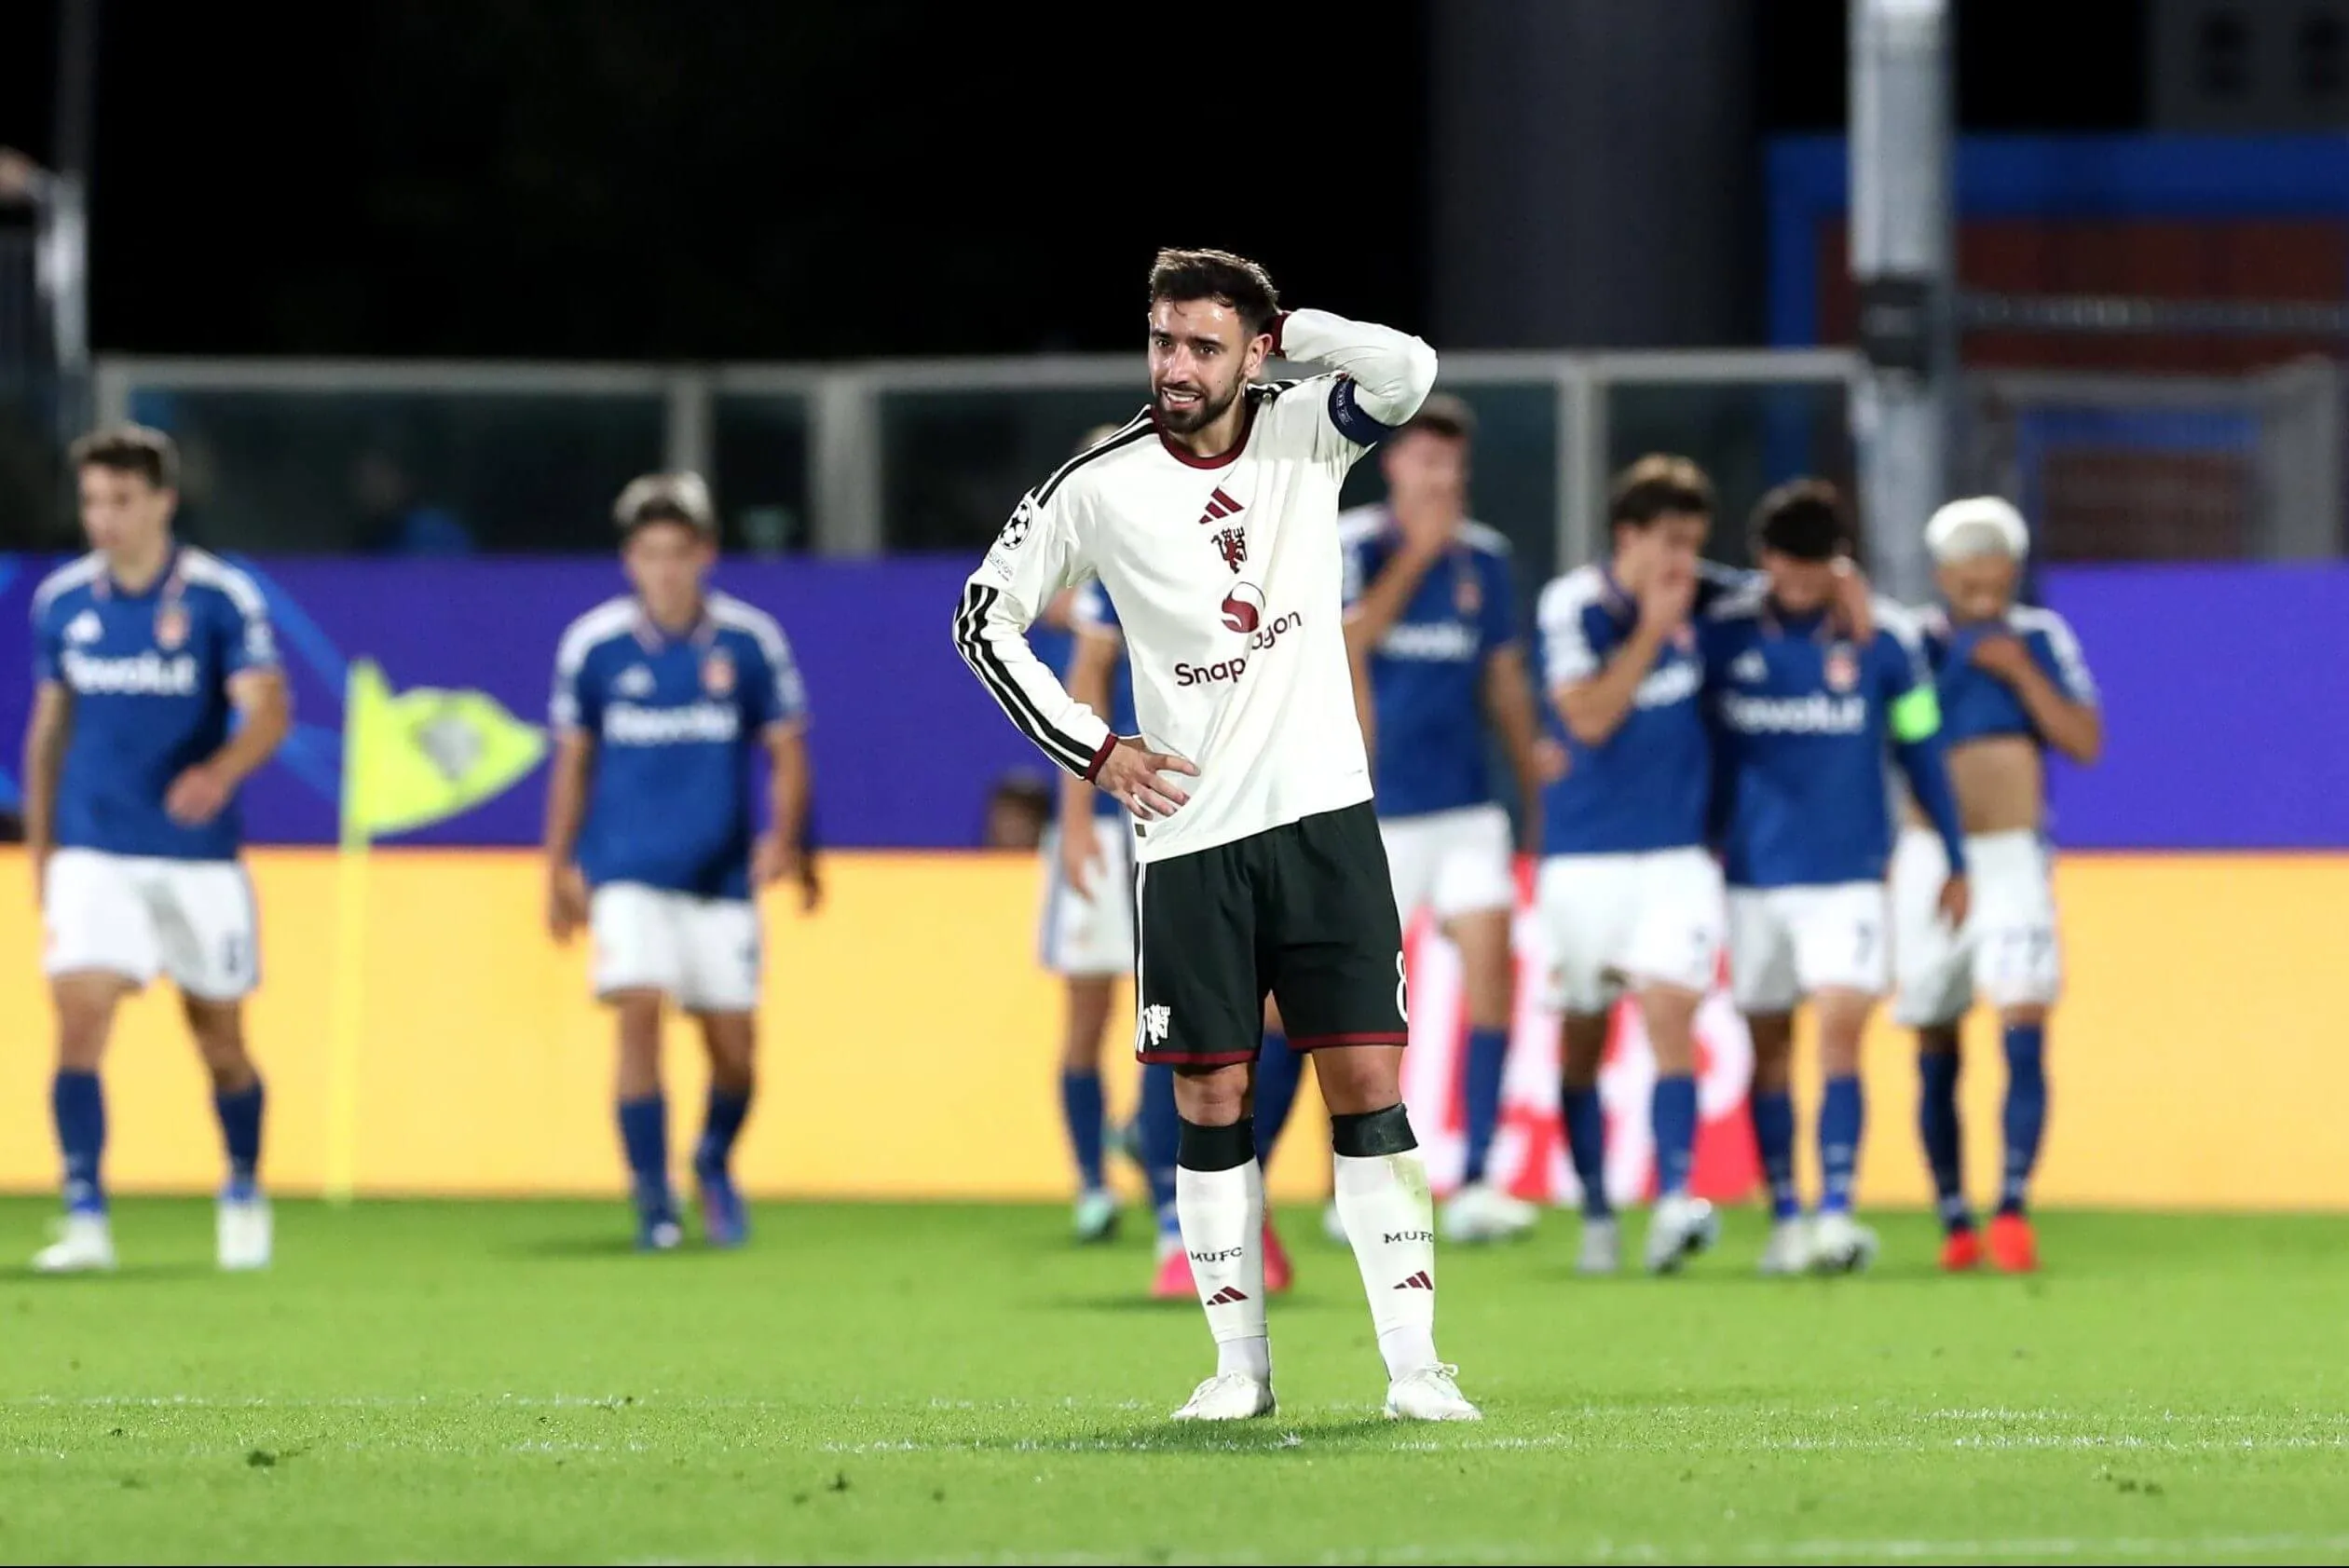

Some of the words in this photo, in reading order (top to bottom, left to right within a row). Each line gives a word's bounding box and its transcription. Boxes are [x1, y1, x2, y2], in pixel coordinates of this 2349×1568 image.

[1174, 611, 1303, 687] Snapagon
[1396, 950, 1408, 1023] 8
[1190, 1247, 1243, 1263] MUFC
